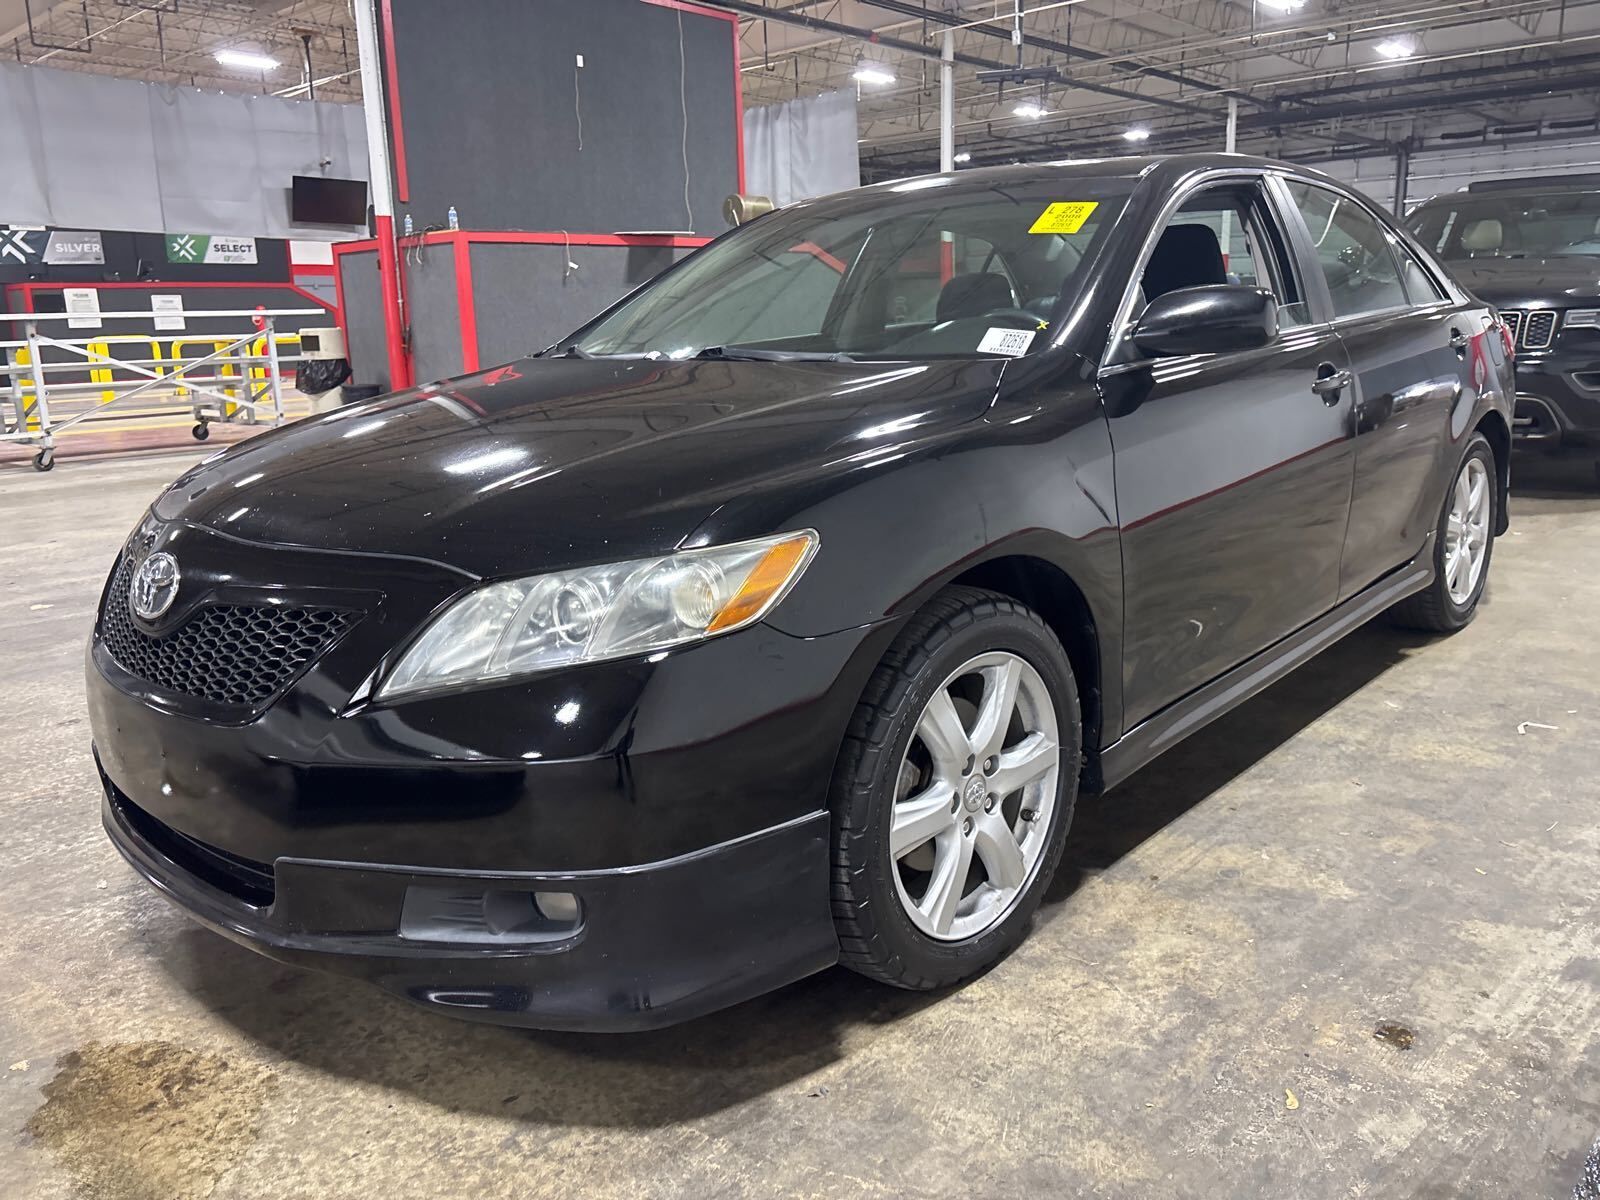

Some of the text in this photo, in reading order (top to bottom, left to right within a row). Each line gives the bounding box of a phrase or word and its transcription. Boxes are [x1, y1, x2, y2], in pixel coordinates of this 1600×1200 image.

[1062, 206, 1084, 214] 278
[55, 243, 101, 253] SILVER
[213, 243, 253, 253] SELECT
